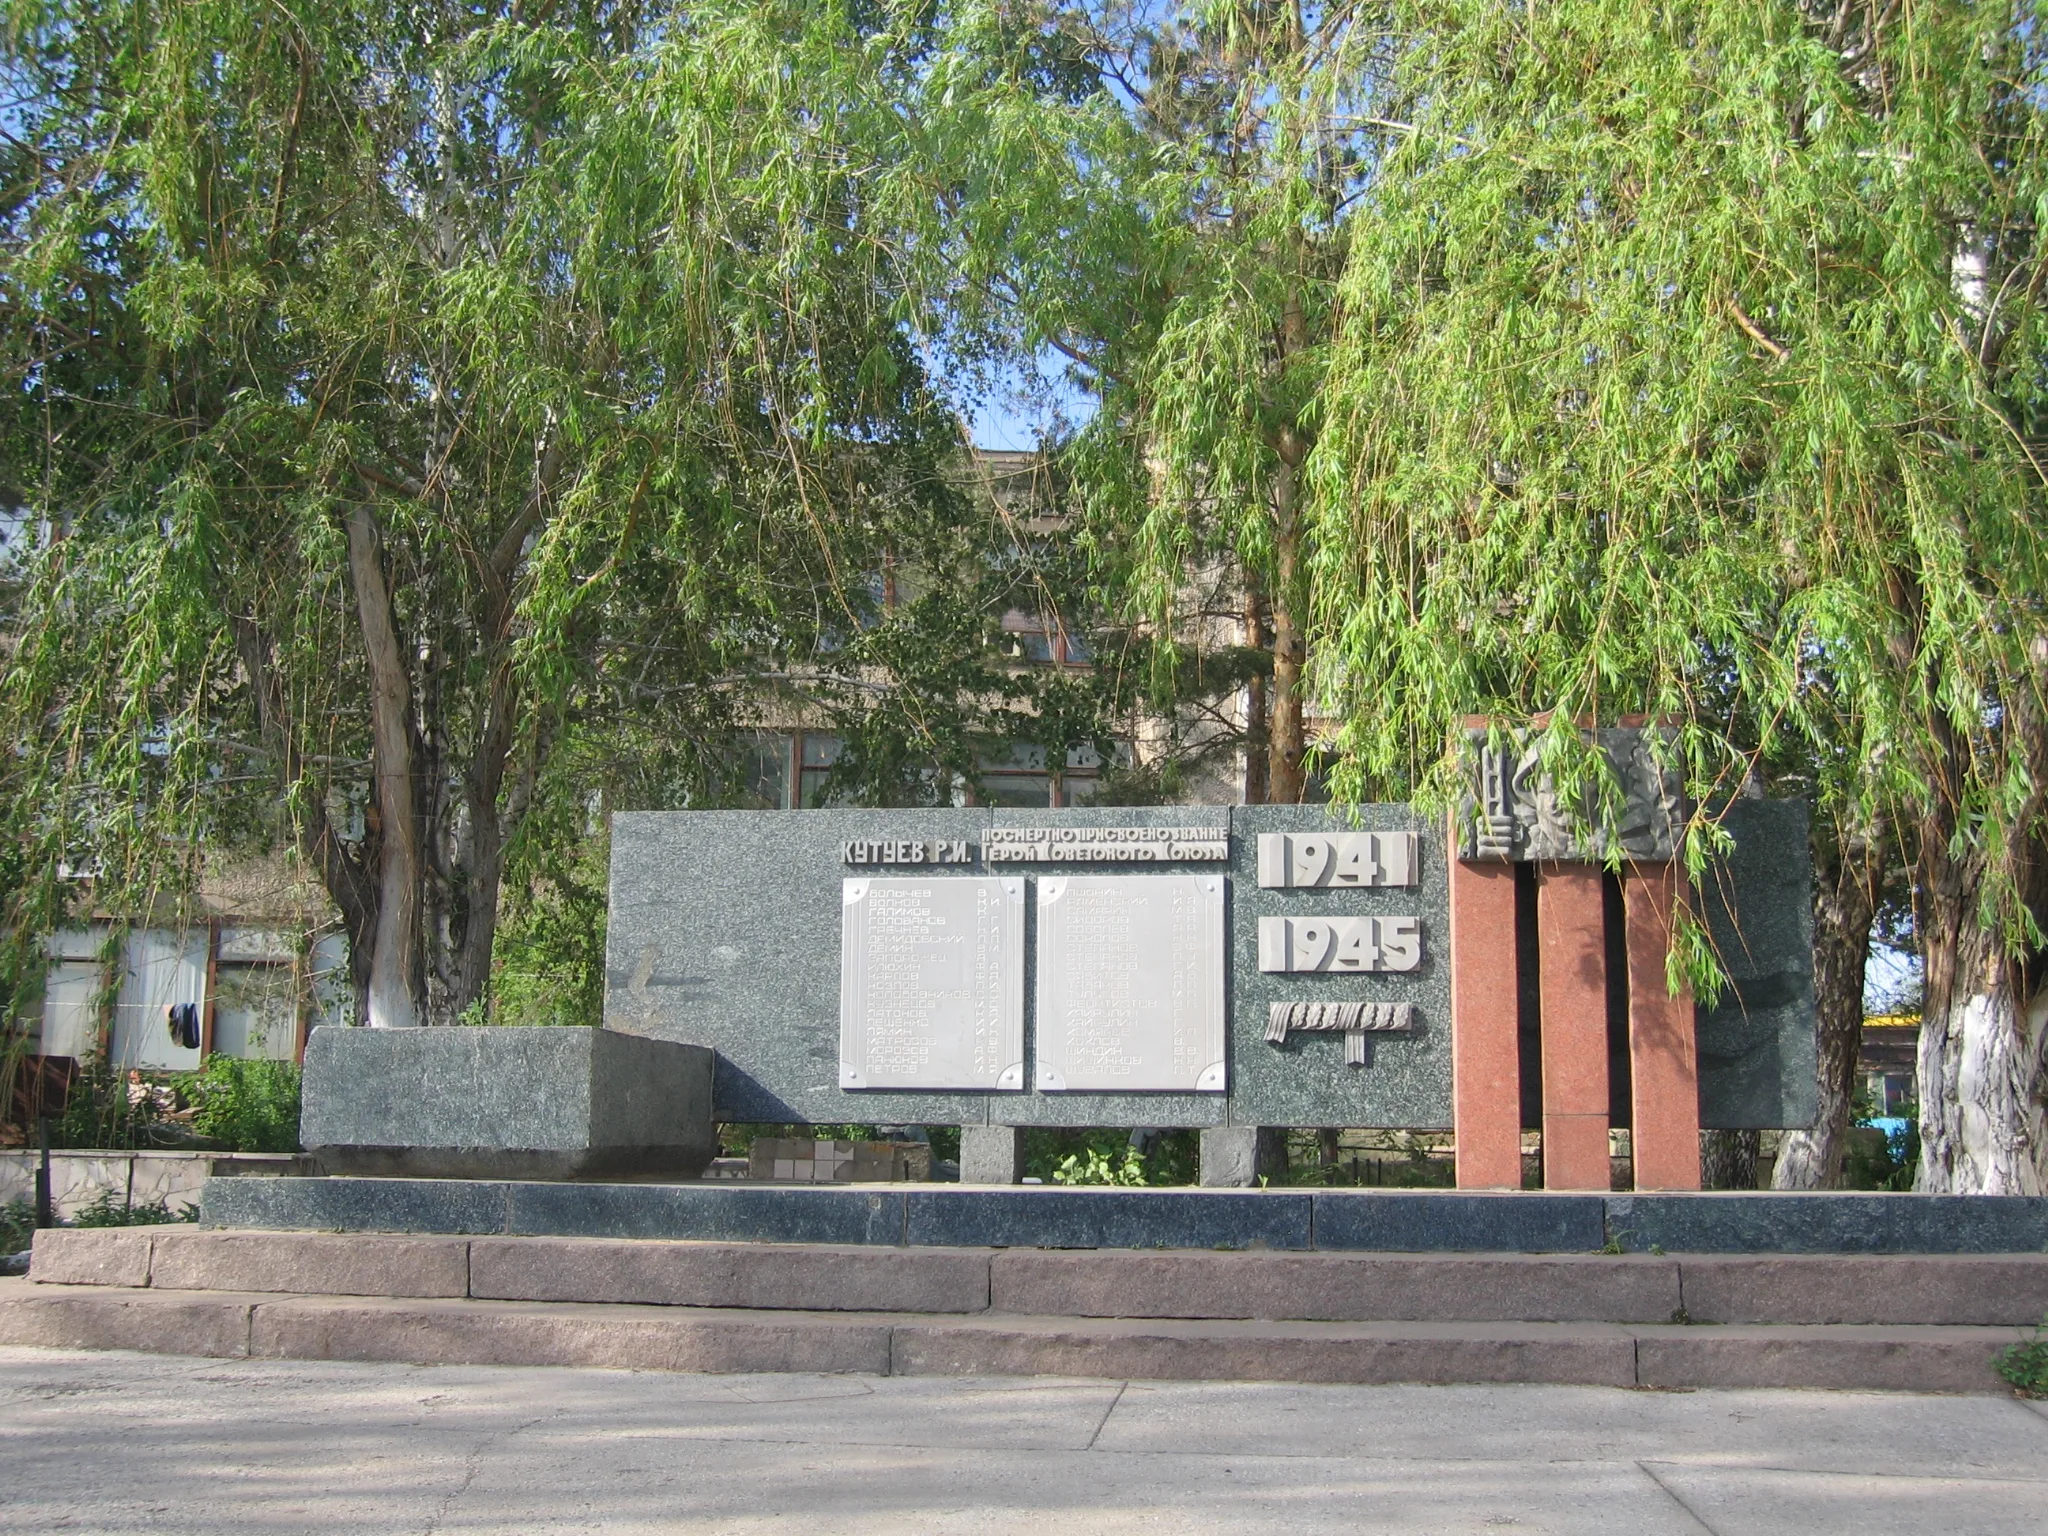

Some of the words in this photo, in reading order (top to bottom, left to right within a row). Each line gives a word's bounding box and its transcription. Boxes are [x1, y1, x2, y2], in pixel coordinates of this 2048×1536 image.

[840, 839, 924, 863] КУТУЕВ
[1263, 833, 1413, 887] 1941
[869, 889, 932, 898] БОЛЫЧЕВ
[869, 898, 921, 907] ВОЛКОВ
[869, 908, 931, 916] ГАЛИМОВ
[868, 917, 946, 925] ГОЛОВАНОВ
[1263, 916, 1420, 972] 1945
[866, 1065, 918, 1074] ПЕТРОВ
